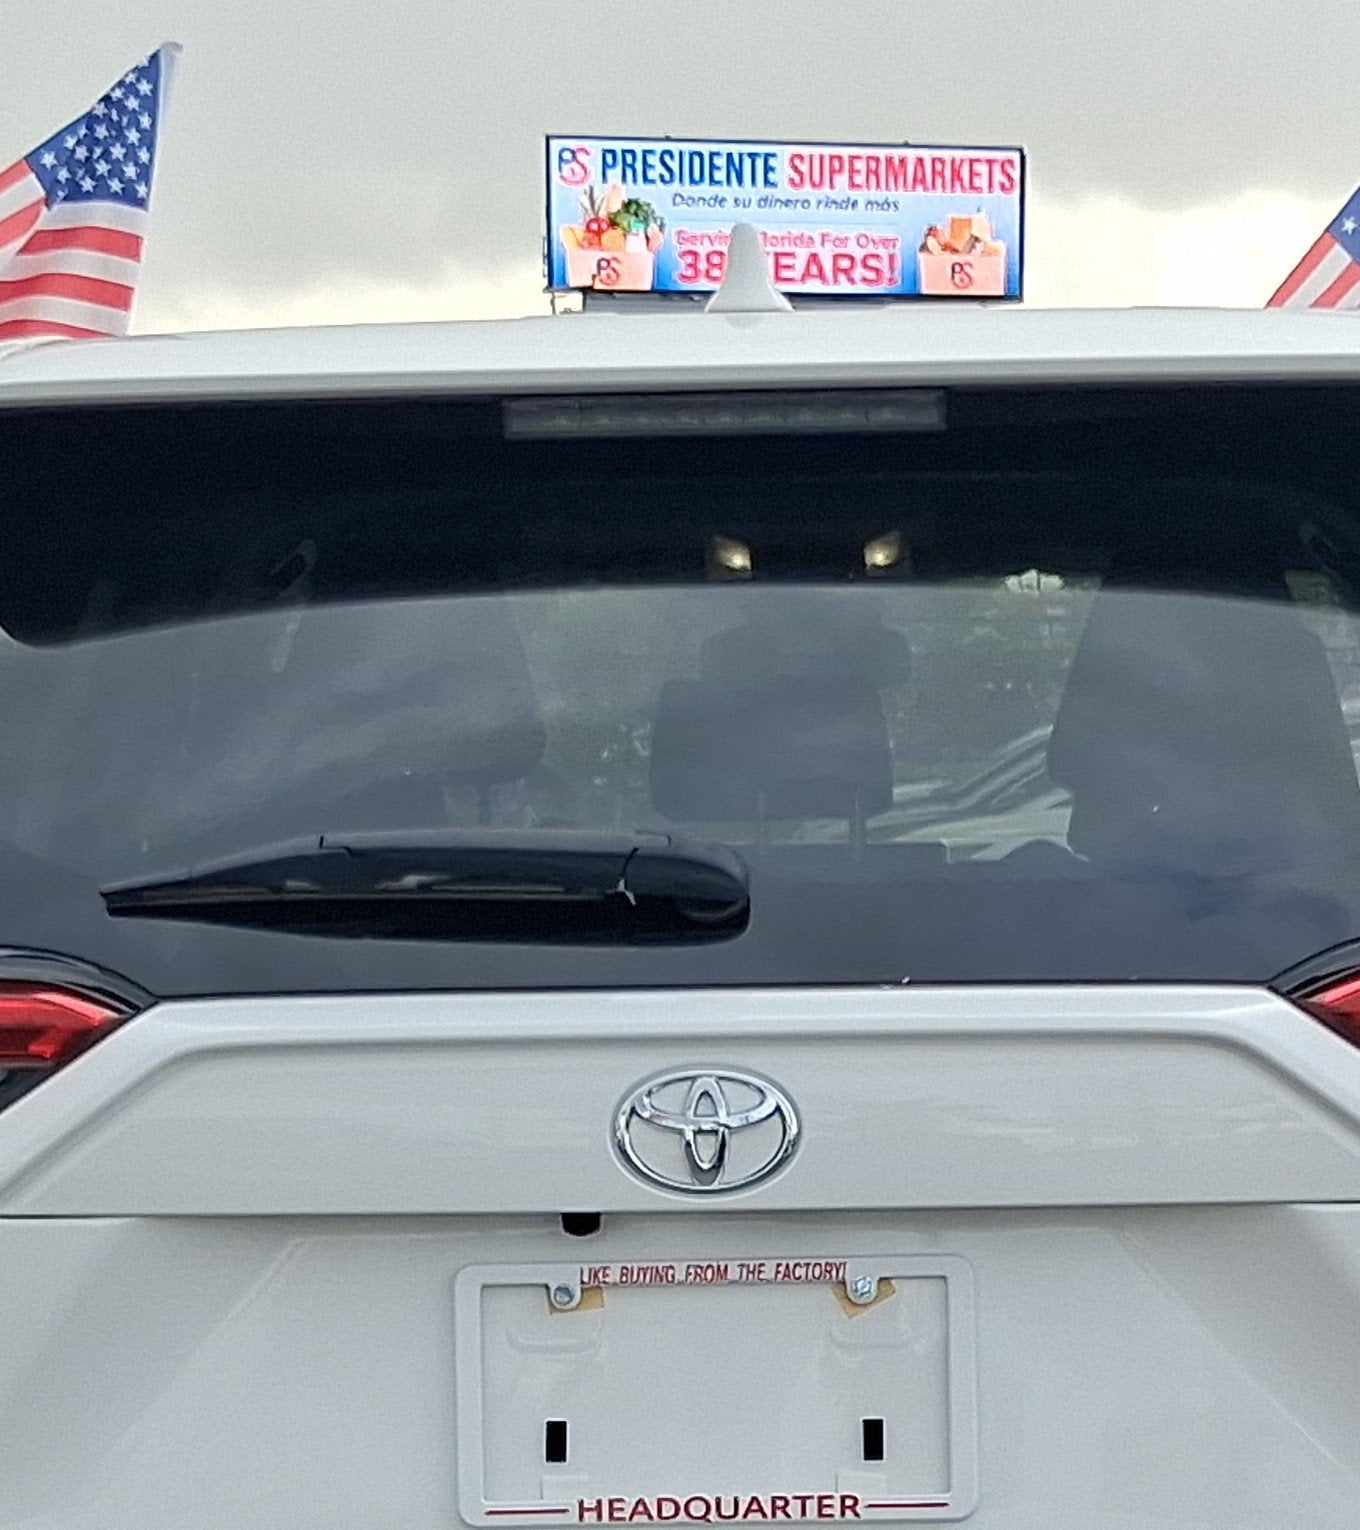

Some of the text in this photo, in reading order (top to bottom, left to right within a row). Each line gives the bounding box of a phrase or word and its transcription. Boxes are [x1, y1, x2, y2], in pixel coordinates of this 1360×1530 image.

[601, 147, 779, 189] PRESIDENTE
[788, 152, 1017, 195] SUPERMARKETS
[672, 192, 900, 213] Donde su dinero rinde más
[677, 229, 730, 246] Servin
[767, 251, 899, 287] EARS!
[580, 1265, 611, 1285] LIKE
[619, 1265, 677, 1285] BUYING
[685, 1262, 729, 1283] FROM
[737, 1262, 767, 1281] THE
[577, 1493, 862, 1524] HEADQUARTER
